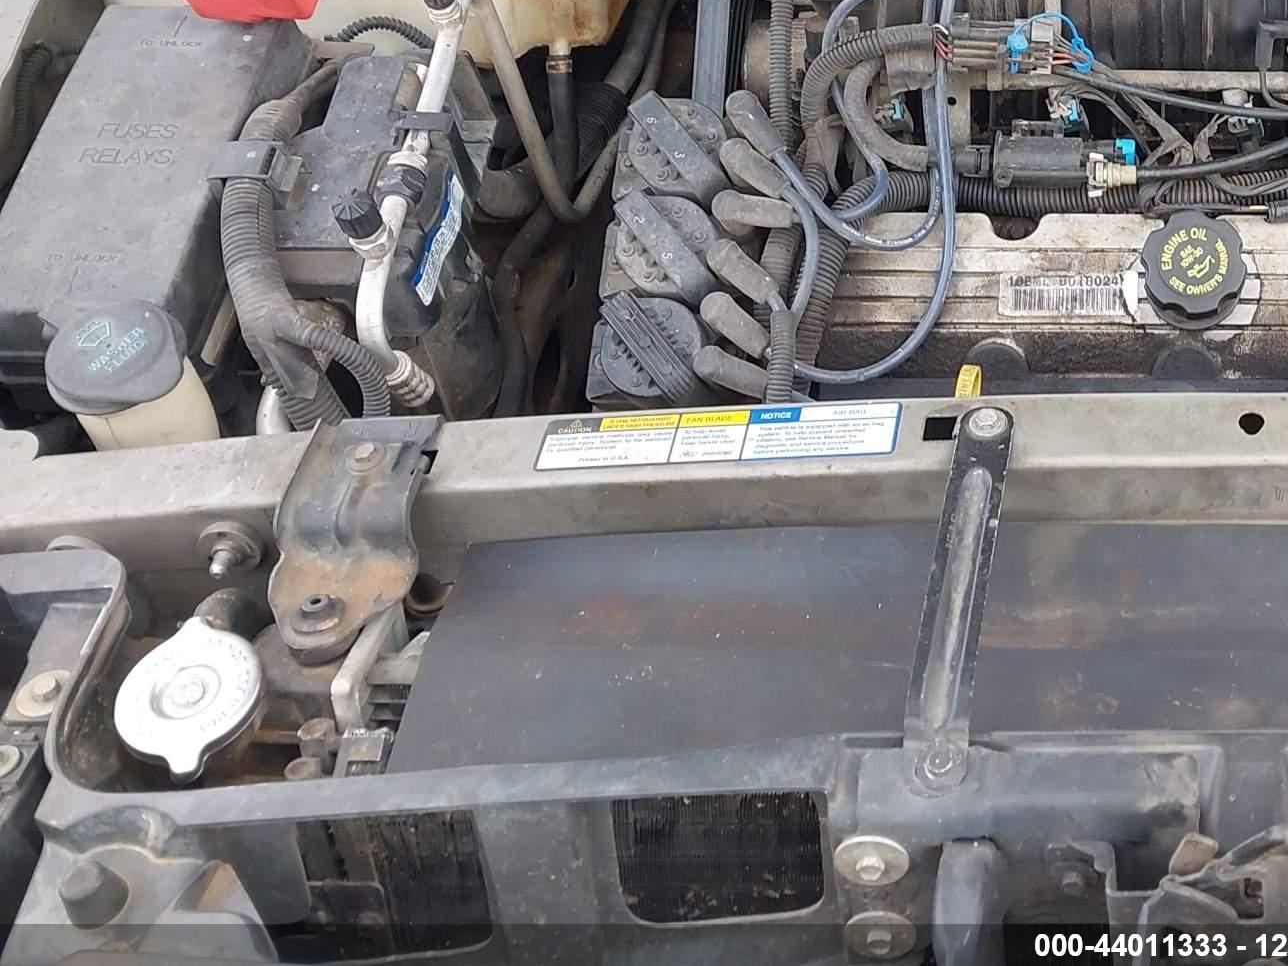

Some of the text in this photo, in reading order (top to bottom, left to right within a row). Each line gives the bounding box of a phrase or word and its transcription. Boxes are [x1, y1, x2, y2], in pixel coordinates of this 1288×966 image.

[96, 121, 179, 139] FUSES
[78, 147, 174, 165] RELAYS
[1161, 227, 1208, 271] ENGINE OIL
[1169, 275, 1187, 293] SEE
[87, 327, 145, 372] WASHER
[104, 340, 145, 373] FLUID
[760, 412, 793, 420] NOTICE
